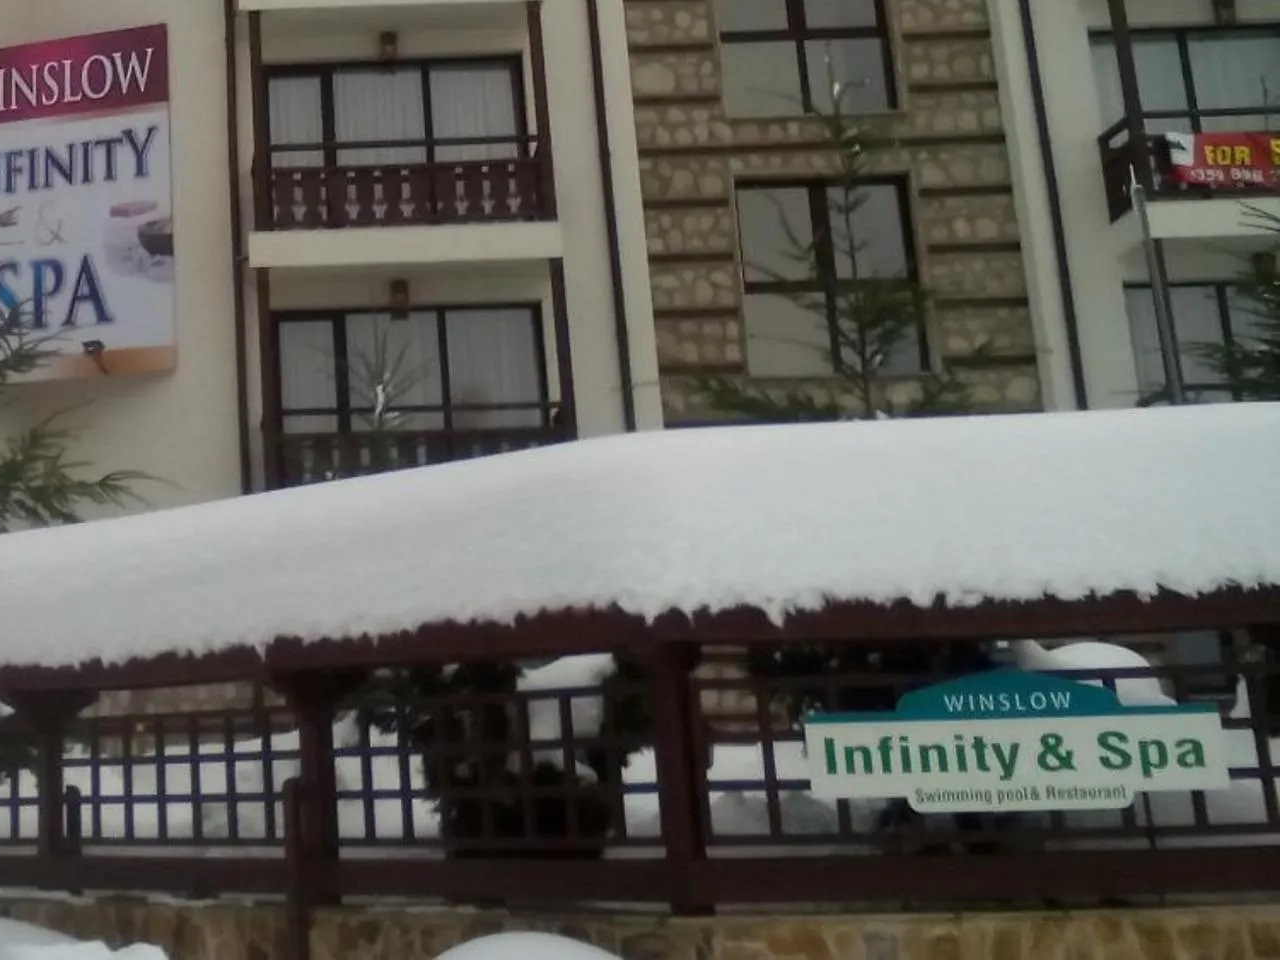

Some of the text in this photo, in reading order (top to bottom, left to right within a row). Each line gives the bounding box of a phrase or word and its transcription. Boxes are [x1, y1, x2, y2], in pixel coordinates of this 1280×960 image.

[1204, 144, 1252, 166] FOR
[34, 200, 69, 246] &
[943, 691, 1072, 713] WINSLOW
[823, 730, 1207, 781] Infinity & Spa
[914, 786, 993, 805] Swimming
[1045, 783, 1127, 801] Restaurant
